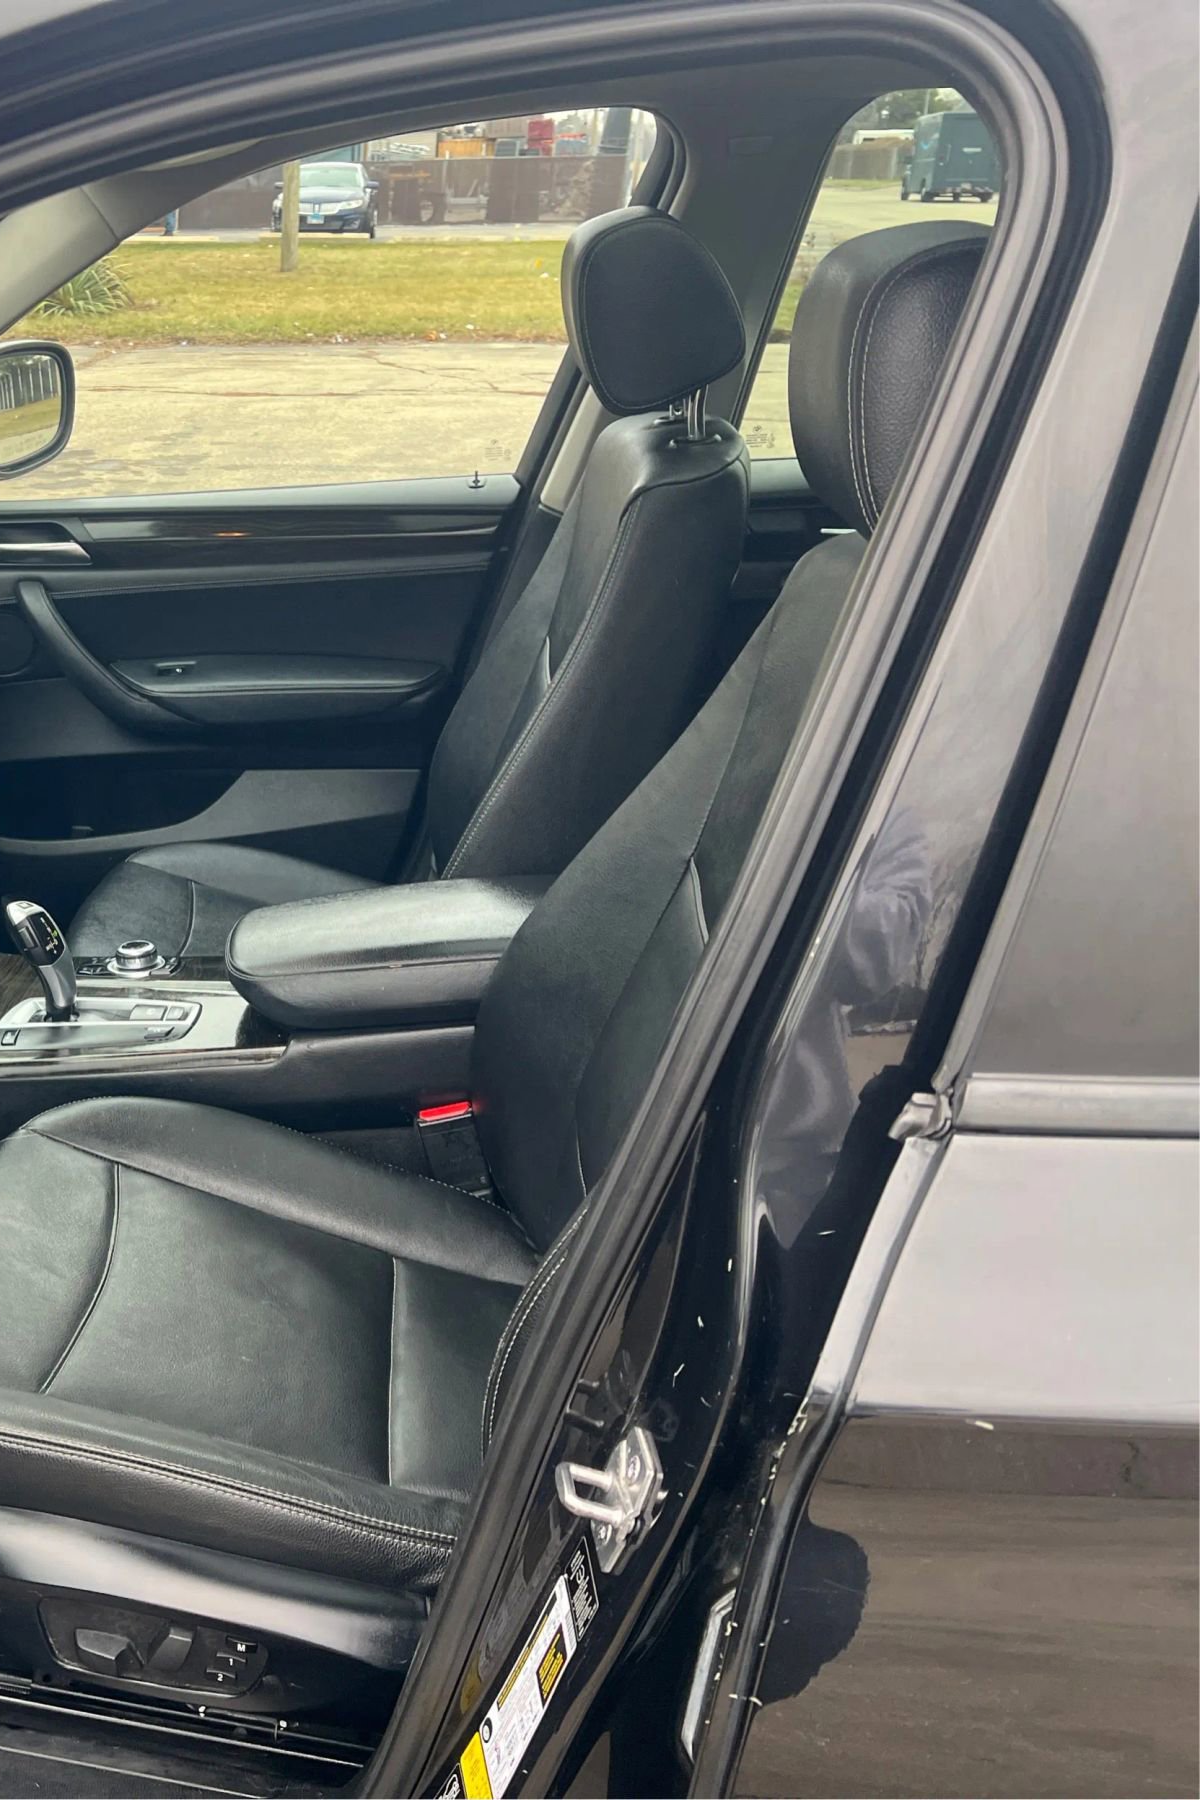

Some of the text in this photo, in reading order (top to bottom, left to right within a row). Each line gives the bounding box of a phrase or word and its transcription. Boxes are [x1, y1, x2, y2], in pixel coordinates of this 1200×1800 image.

[237, 1643, 246, 1652] M
[229, 1658, 233, 1666] 1
[217, 1673, 224, 1682] 2
